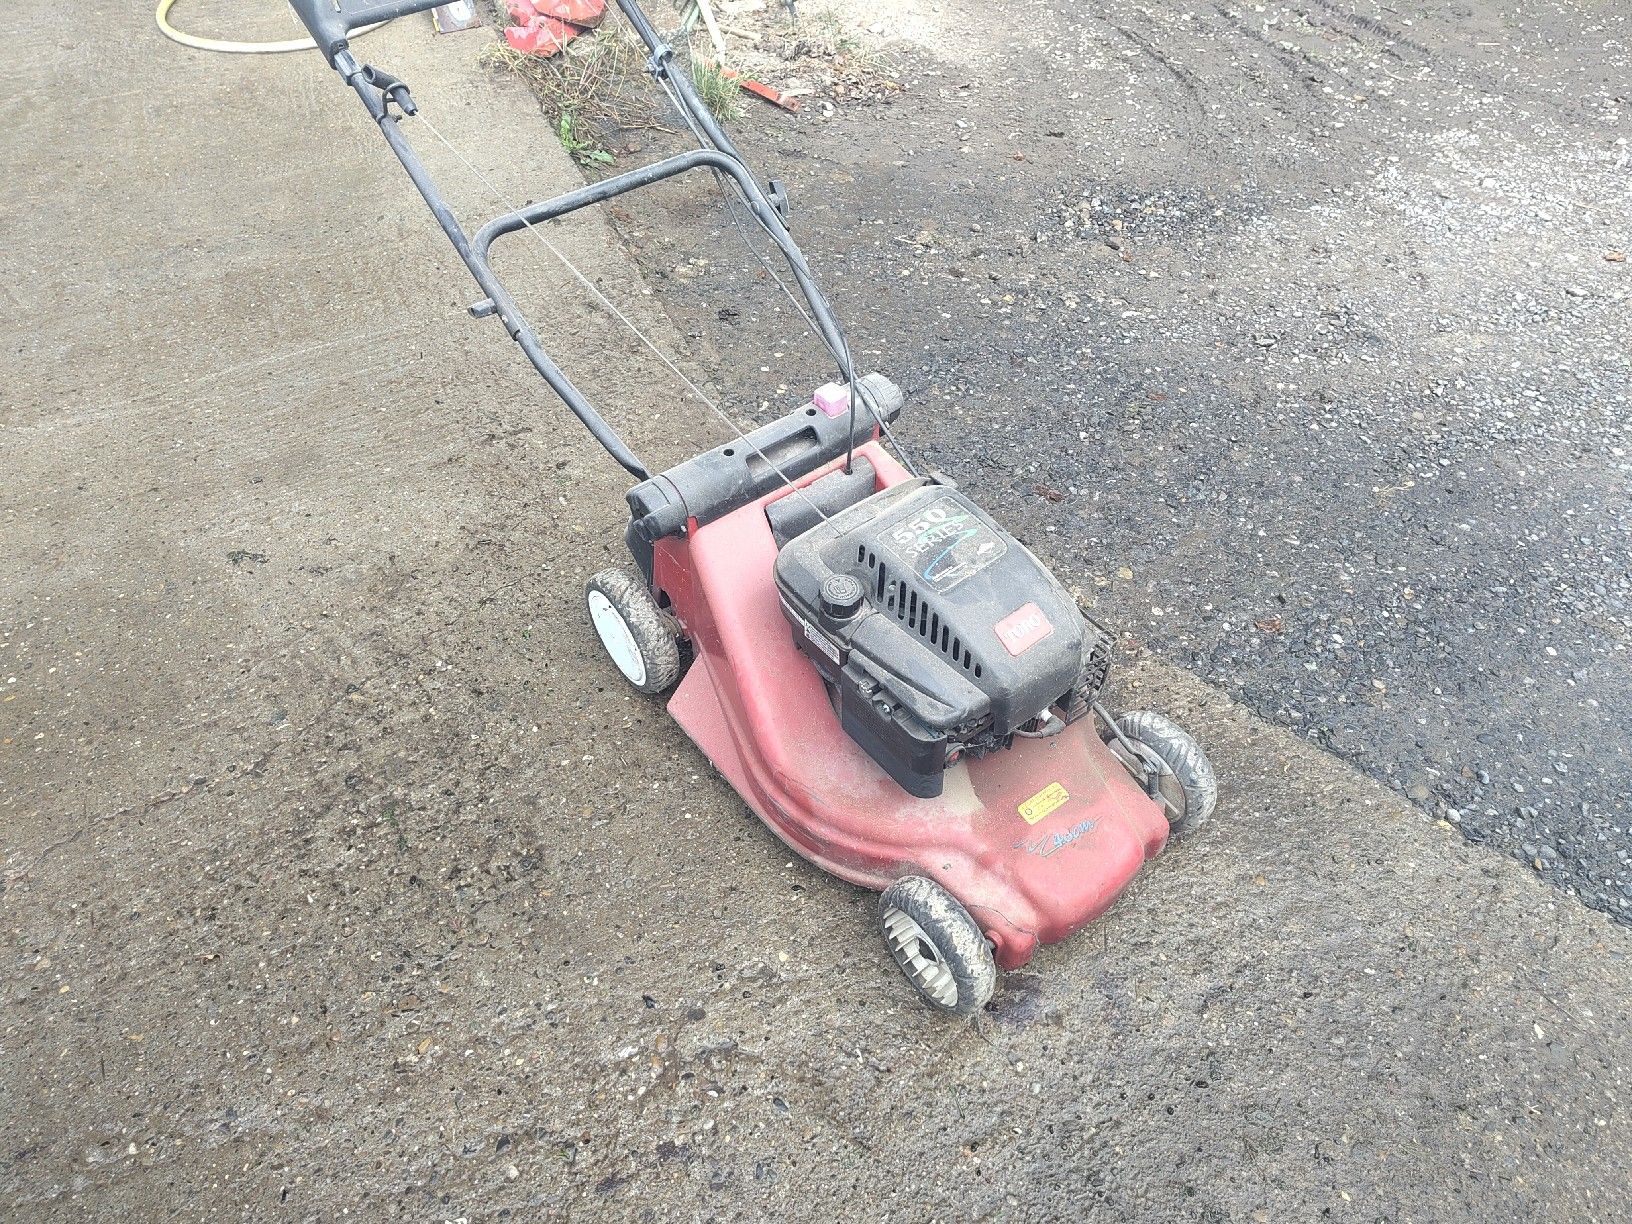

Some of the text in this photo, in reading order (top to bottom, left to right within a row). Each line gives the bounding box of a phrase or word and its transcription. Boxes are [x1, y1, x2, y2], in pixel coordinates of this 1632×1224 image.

[891, 508, 947, 544] 550
[905, 522, 964, 558] SERIES
[1003, 612, 1042, 643] TORO
